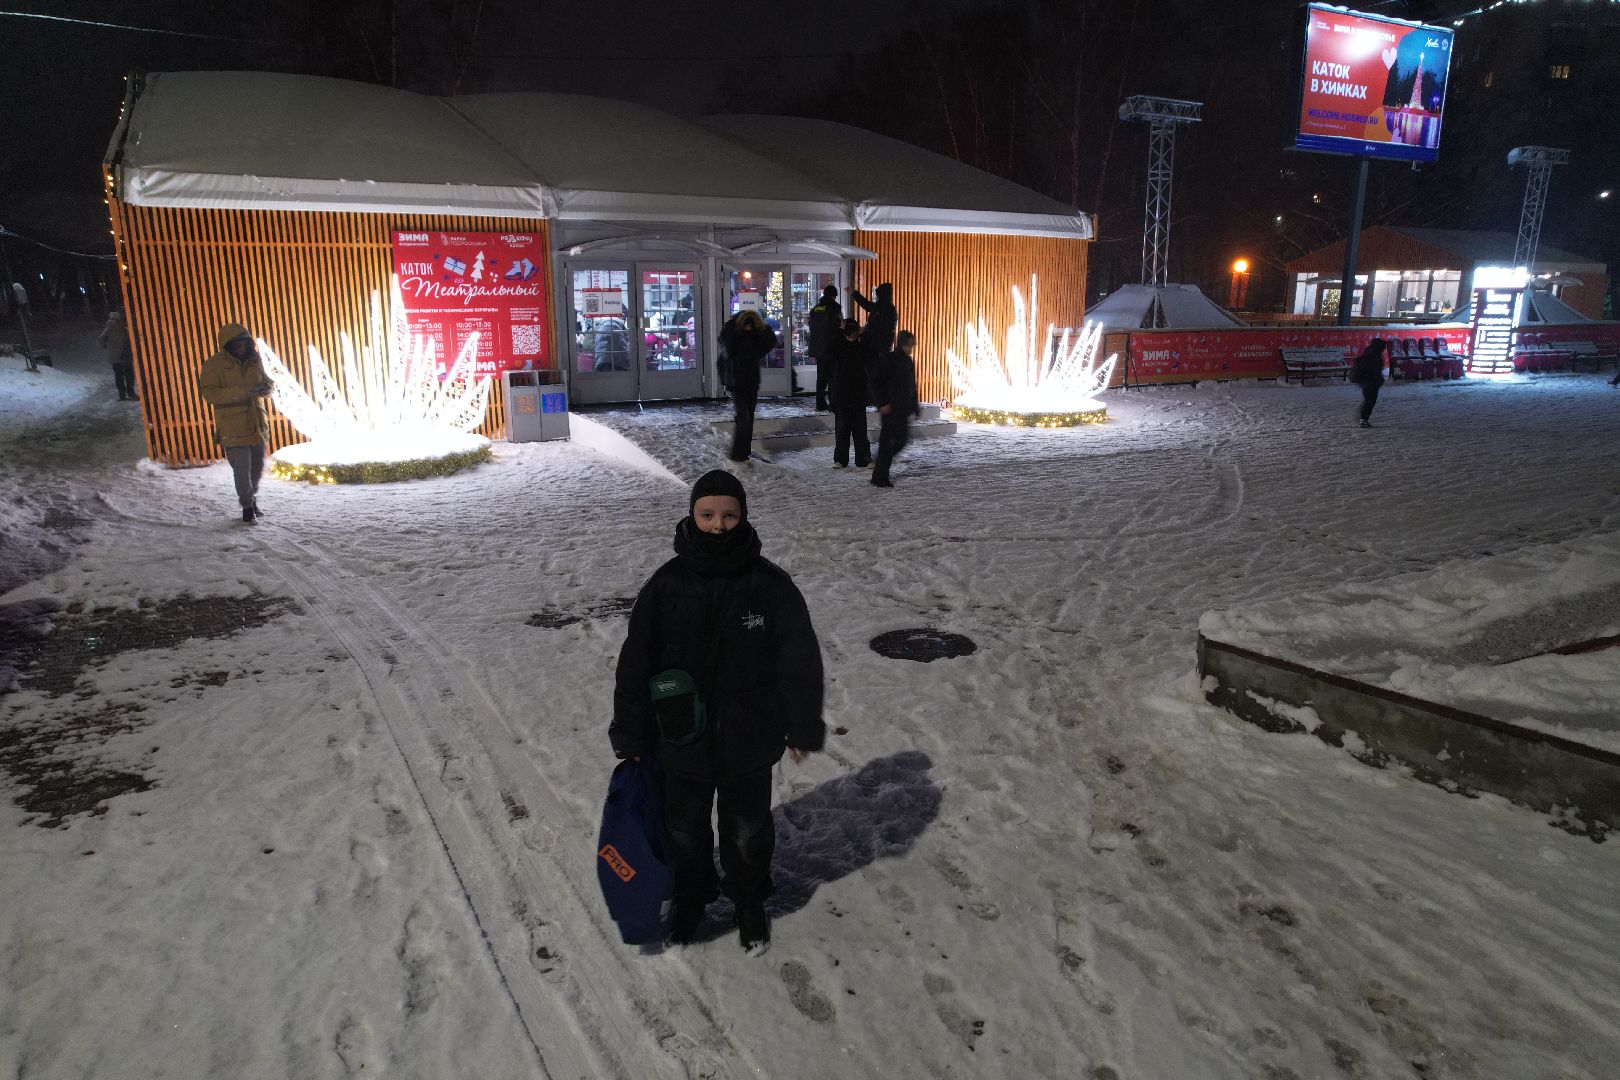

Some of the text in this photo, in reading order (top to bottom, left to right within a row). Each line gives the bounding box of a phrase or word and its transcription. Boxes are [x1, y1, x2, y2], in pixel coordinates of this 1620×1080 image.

[1312, 60, 1350, 79] КАТОК
[1310, 78, 1367, 100] В ХИМКАХ
[398, 233, 429, 242] ЗИМА
[401, 262, 434, 276] КАТОК
[401, 276, 540, 305] Театральный
[1142, 350, 1170, 360] ЗИМА
[601, 847, 630, 878] PRO
